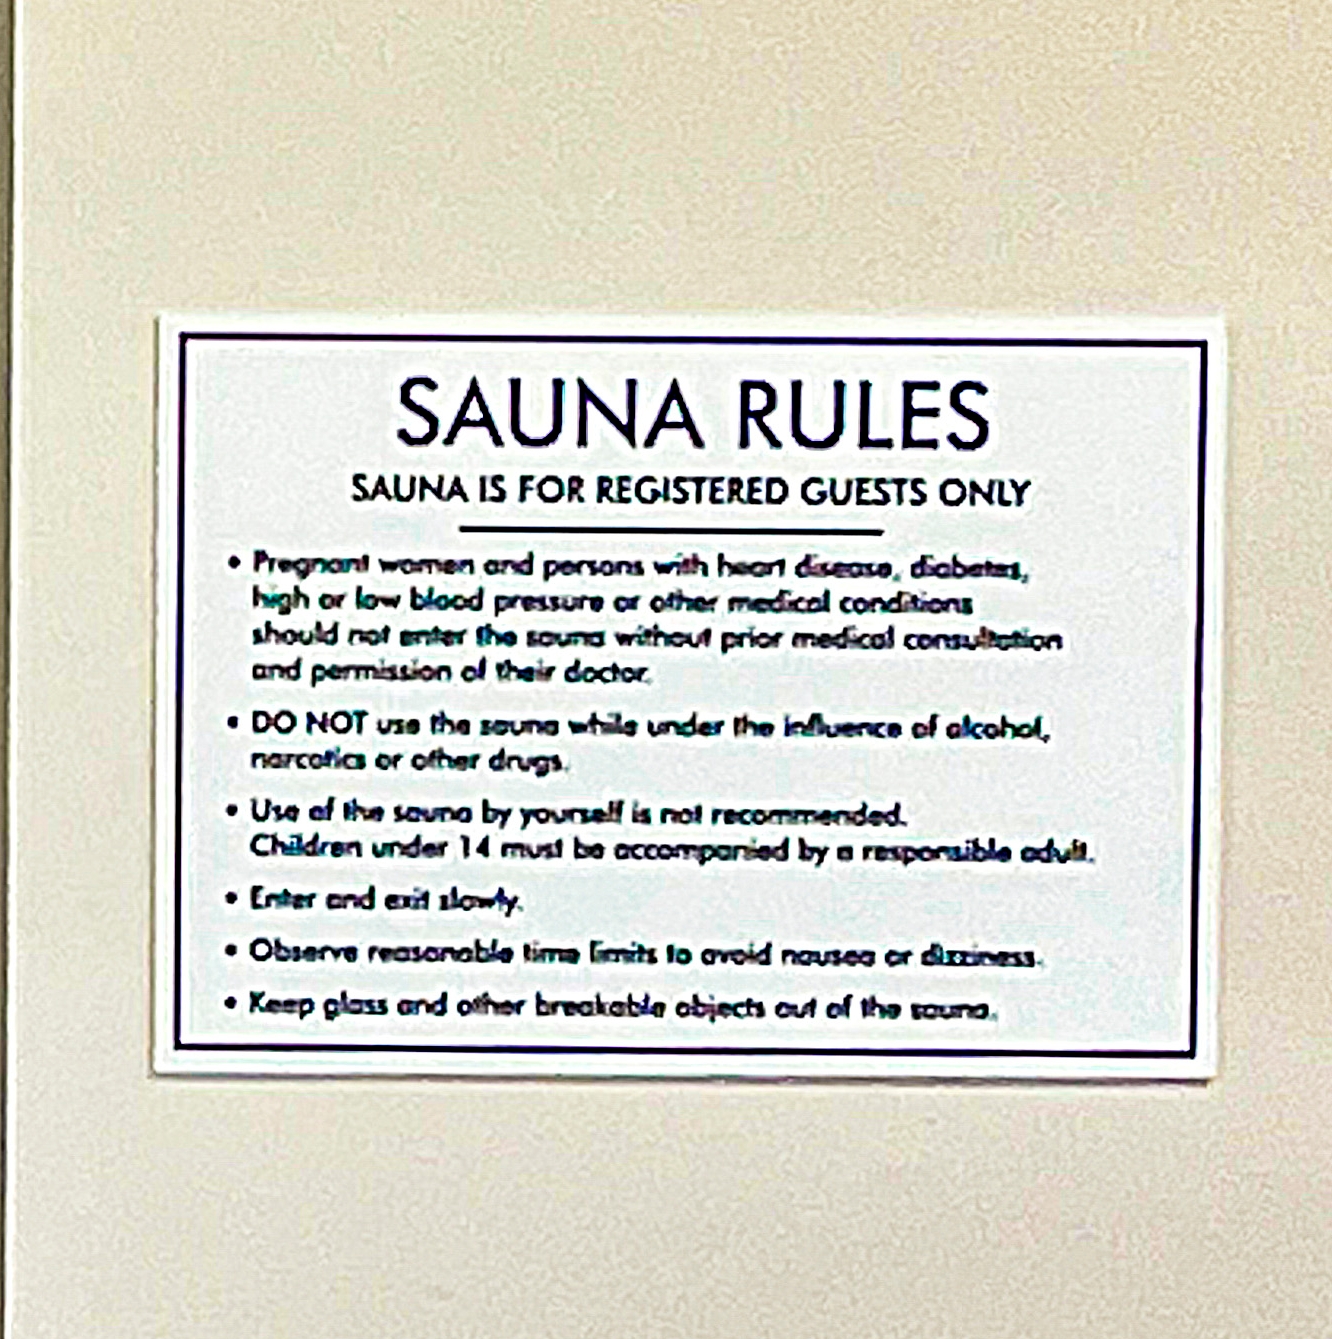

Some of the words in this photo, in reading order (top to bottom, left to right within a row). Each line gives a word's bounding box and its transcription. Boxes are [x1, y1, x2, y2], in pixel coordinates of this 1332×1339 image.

[397, 376, 705, 449] SAUNA
[739, 380, 989, 451] RULES
[352, 473, 469, 502] SAUNA
[479, 474, 507, 503] IS
[518, 475, 585, 503] FOR
[596, 475, 789, 505] REGISTERED
[801, 477, 927, 506] GUESTS
[939, 478, 1031, 507] ONLY
[252, 549, 370, 581] Pregnant
[377, 558, 476, 576] women
[482, 550, 535, 576] and
[542, 559, 645, 582] persons
[652, 552, 709, 578] with
[716, 552, 787, 578] heart
[794, 553, 901, 582] disease,
[910, 553, 1029, 584] diabetes,
[252, 583, 311, 616] high
[317, 593, 347, 611] or
[355, 585, 402, 611] low
[409, 585, 485, 612] blood
[493, 594, 605, 618] pressure
[612, 594, 642, 613] or
[648, 588, 719, 614] other
[727, 588, 831, 614] medical
[838, 590, 974, 616] conditions
[252, 620, 340, 647] should
[347, 624, 392, 647] not
[399, 625, 468, 648] enter
[475, 622, 518, 648] the
[525, 630, 607, 648] sauna
[613, 623, 713, 649] without
[720, 626, 785, 655] prior
[791, 624, 896, 651] medical
[902, 625, 1064, 652] consultation
[251, 656, 303, 682] and
[310, 659, 453, 688] permission
[459, 655, 488, 683] of
[494, 658, 557, 683] their
[563, 658, 653, 685] doctor.
[251, 709, 298, 735] DO
[305, 709, 370, 735] NOT
[375, 718, 421, 736] use
[429, 710, 471, 736] the
[479, 719, 560, 737] sauna
[567, 711, 639, 738] while
[646, 711, 726, 738] under
[732, 713, 776, 738] the
[783, 712, 903, 739] influence
[910, 713, 940, 740] of
[945, 714, 1051, 744] alcohol,
[250, 746, 367, 771] narcotics
[374, 752, 404, 771] or
[410, 746, 481, 772] other
[488, 747, 570, 778] drugs.
[249, 797, 301, 823] Use
[308, 795, 336, 822] of
[342, 797, 386, 823] the
[393, 804, 474, 824] sauna
[481, 798, 513, 830] by
[519, 799, 625, 831] yourself
[631, 801, 652, 825] is
[659, 804, 703, 825] not
[710, 801, 908, 828] recommended.
[249, 831, 363, 859] Children
[371, 833, 449, 859] under
[459, 834, 490, 860] 14
[500, 835, 564, 860] must
[573, 835, 607, 860] be
[613, 836, 790, 867] accompanied
[797, 836, 831, 868] by
[836, 845, 854, 862] a
[861, 837, 1013, 867] responsible
[1019, 837, 1095, 865] adult.
[249, 884, 317, 911] Enter
[325, 884, 376, 911] and
[383, 887, 431, 911] exit
[438, 885, 524, 918] slowly.
[248, 937, 359, 963] Observe
[367, 938, 515, 964] reasonable
[522, 941, 581, 965] time
[589, 939, 659, 965] limits
[665, 943, 693, 966] to
[700, 941, 773, 966] avoid
[781, 948, 877, 968] nausea
[884, 949, 914, 968] or
[248, 990, 316, 1021] Keep
[322, 989, 389, 1022] glass
[396, 991, 449, 1017] and
[456, 991, 527, 1017] other
[534, 990, 667, 1019] breakable
[674, 993, 767, 1024] objects
[774, 997, 818, 1019] out
[825, 993, 854, 1020] of
[859, 994, 903, 1020] the
[909, 1002, 998, 1021] sauna.
